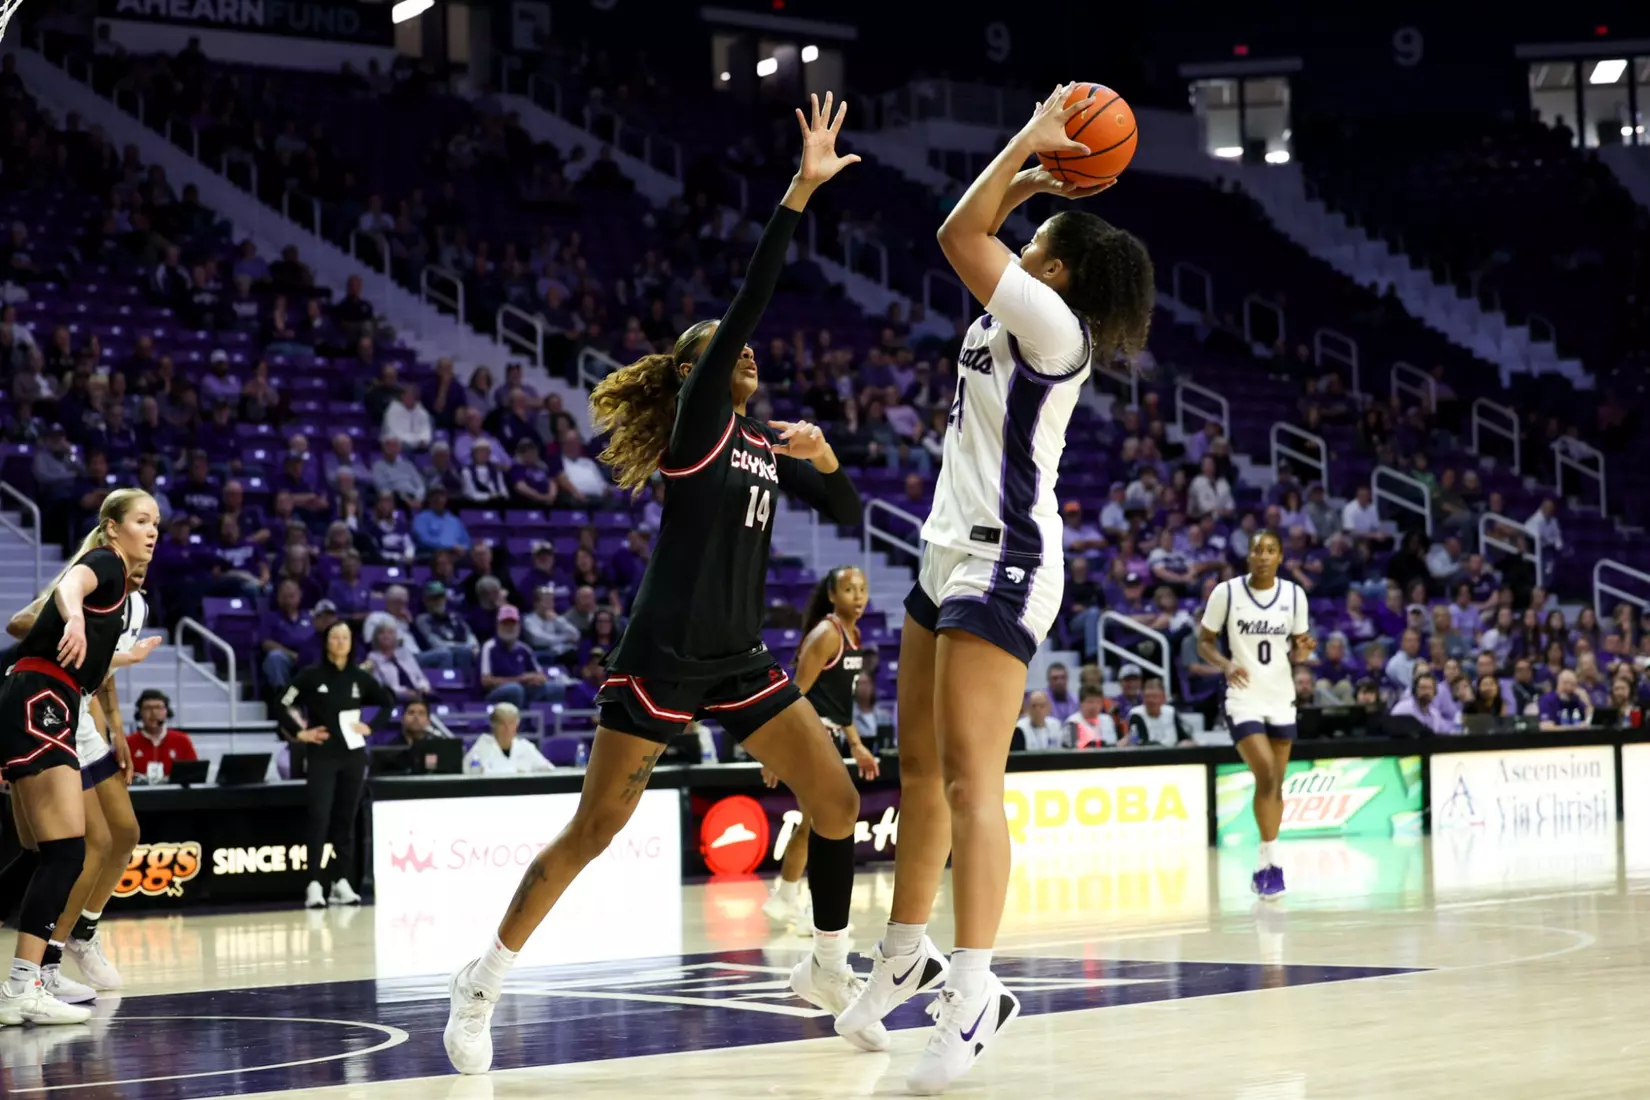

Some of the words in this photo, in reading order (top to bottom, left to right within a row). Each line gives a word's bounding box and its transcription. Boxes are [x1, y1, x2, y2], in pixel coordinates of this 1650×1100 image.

[267, 1, 363, 34] FUND
[984, 20, 1012, 64] 9
[1391, 24, 1425, 67] 9
[744, 485, 771, 531] 14
[1258, 640, 1271, 665] 0
[1496, 753, 1602, 783] Ascension
[1003, 783, 1188, 843] QDOBA
[212, 844, 287, 875] SINCE
